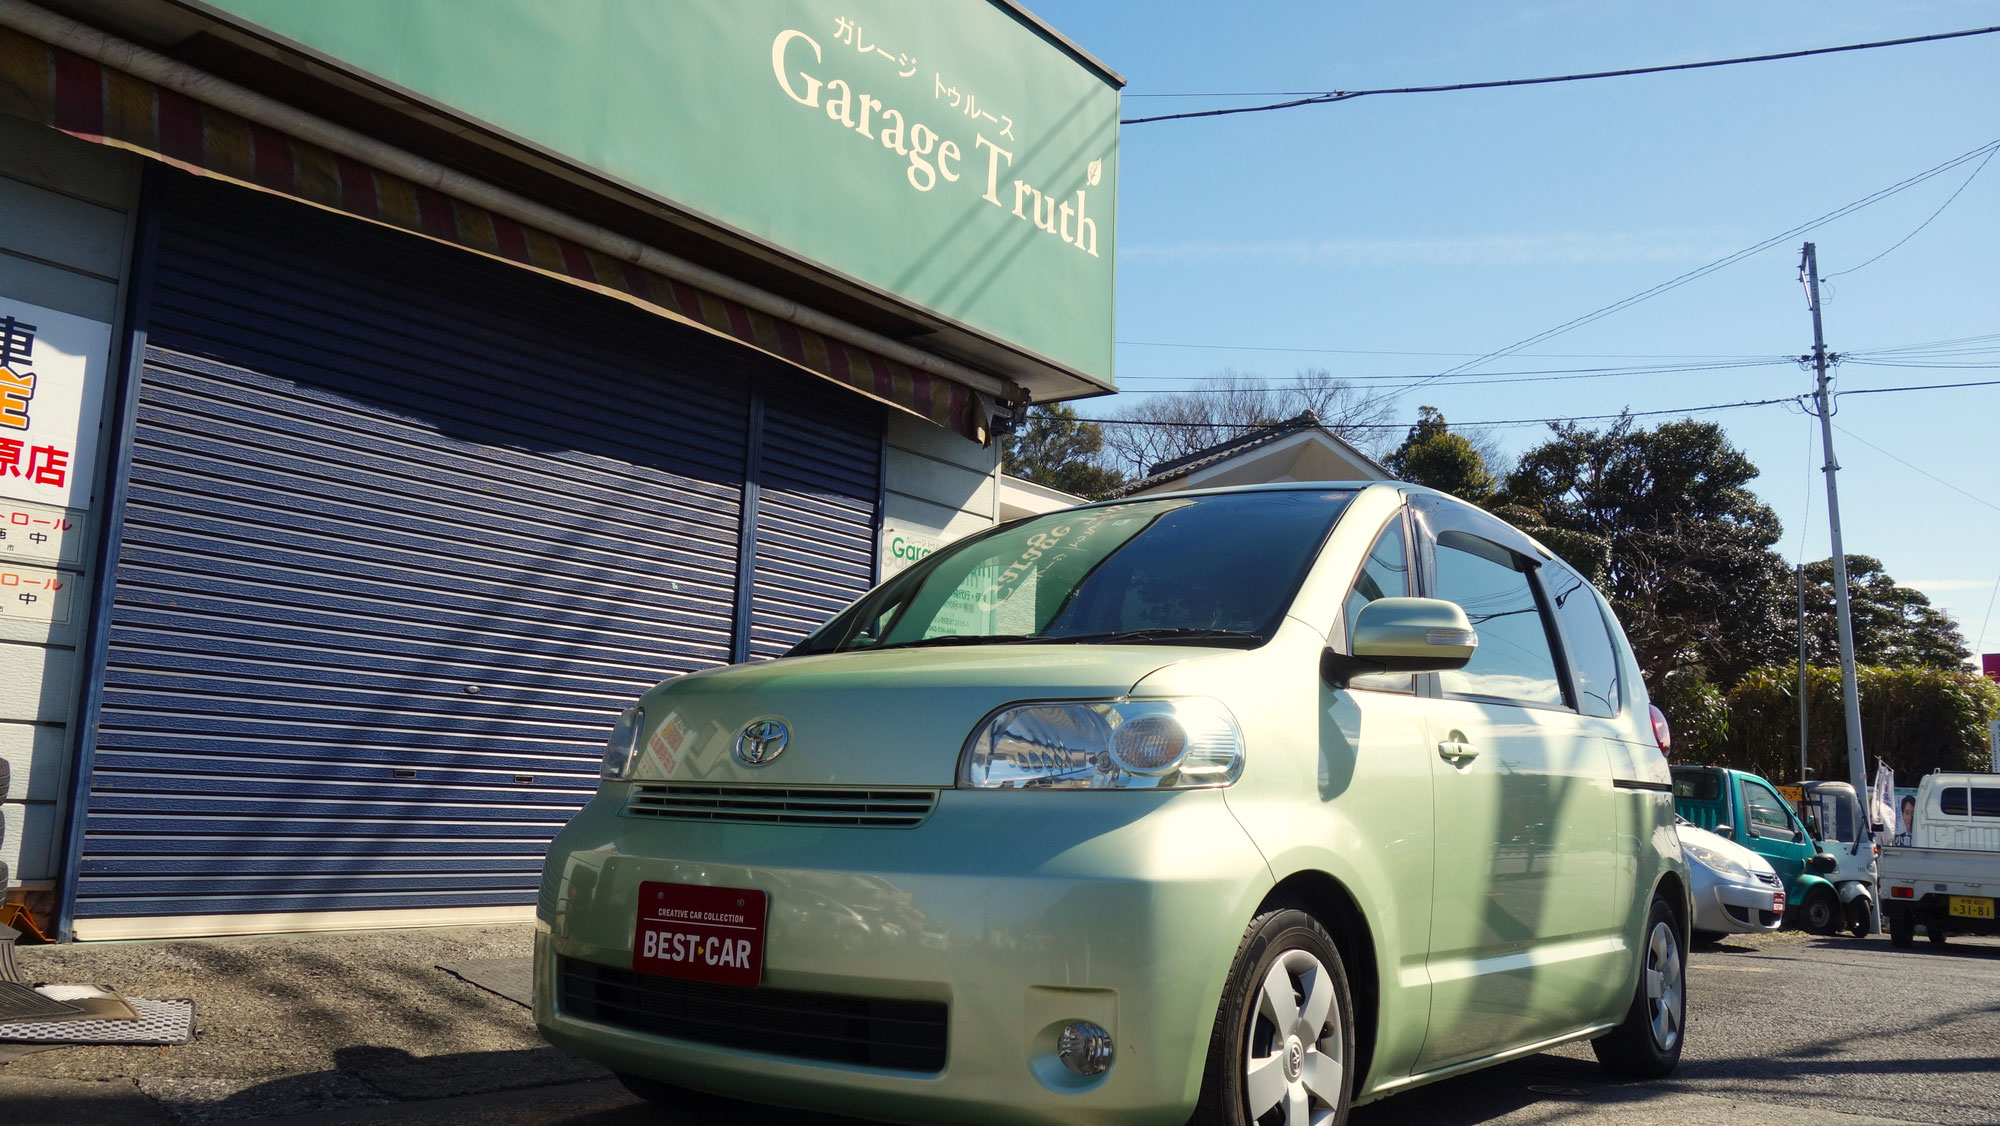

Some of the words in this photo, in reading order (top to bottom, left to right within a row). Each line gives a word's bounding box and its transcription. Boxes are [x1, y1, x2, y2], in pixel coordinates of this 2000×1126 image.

[833, 16, 917, 78] ガレージ
[935, 72, 1015, 142] トゥルース
[772, 29, 961, 192] Garage
[975, 132, 1099, 258] Truth
[0, 512, 72, 531] ロール
[658, 908, 688, 919] CREATIVE
[689, 911, 702, 920] CAR
[703, 912, 744, 923] COLLECTION
[643, 930, 700, 963] BEST
[705, 936, 751, 969] CAR
